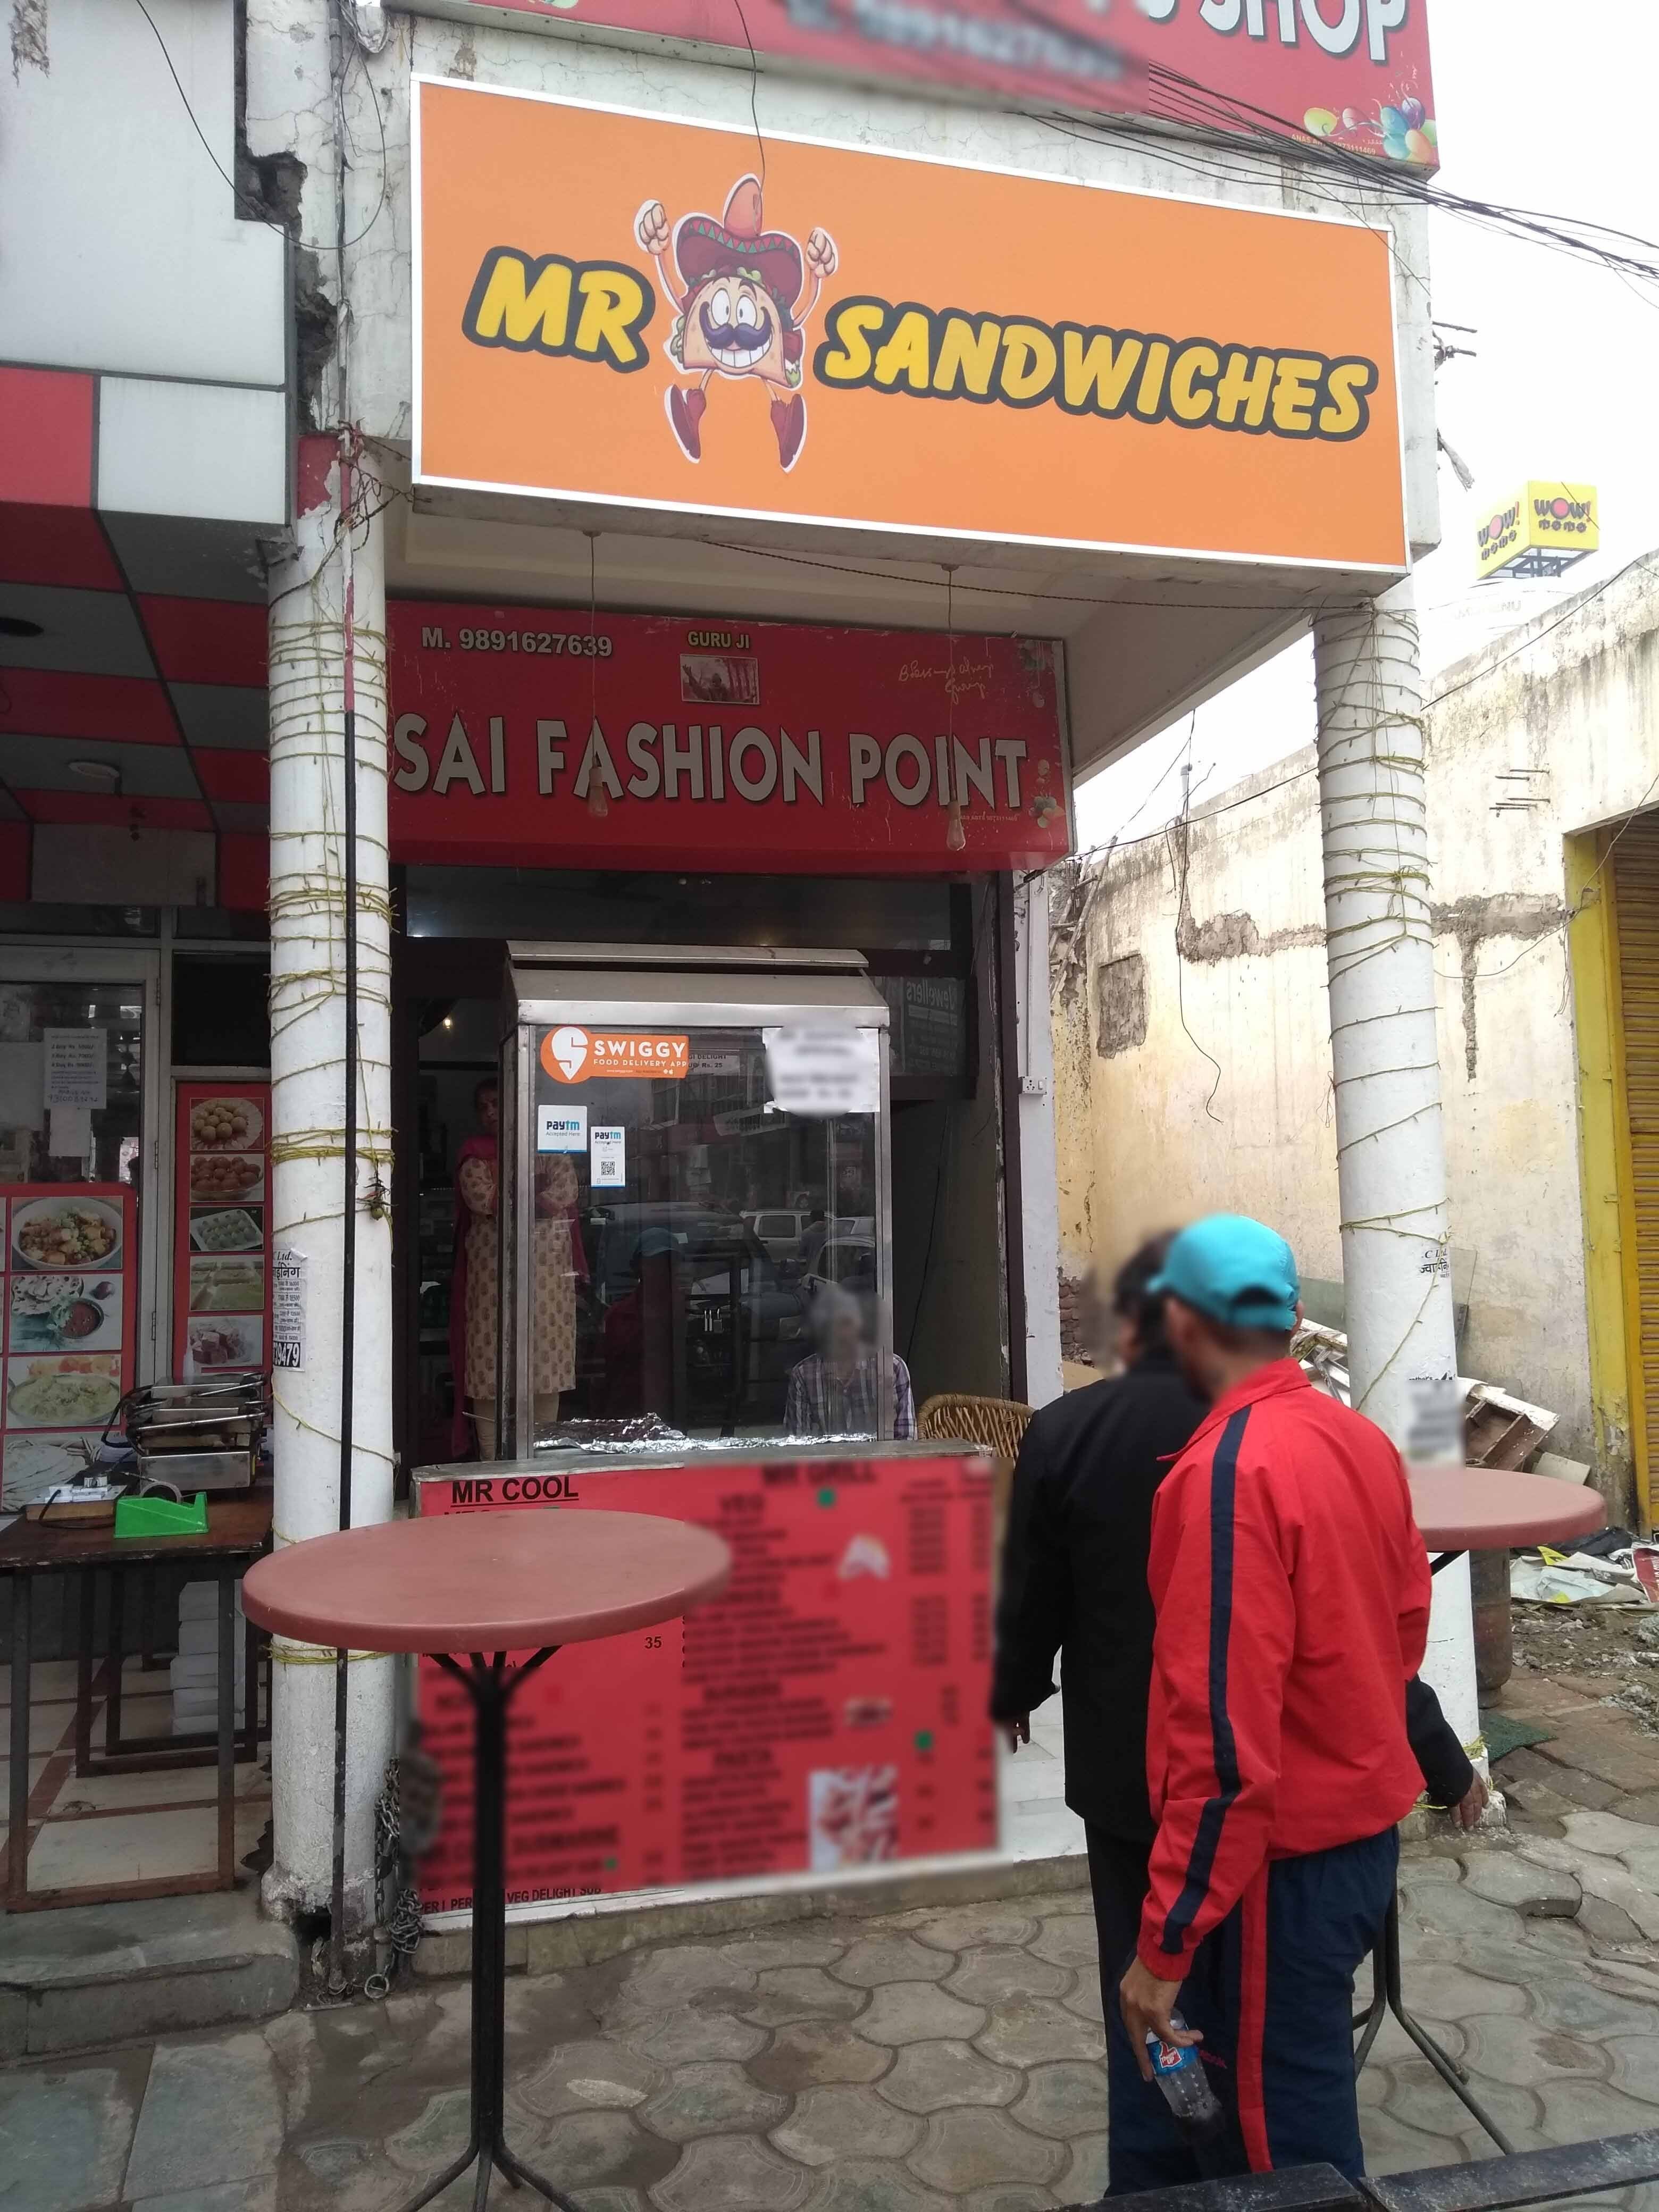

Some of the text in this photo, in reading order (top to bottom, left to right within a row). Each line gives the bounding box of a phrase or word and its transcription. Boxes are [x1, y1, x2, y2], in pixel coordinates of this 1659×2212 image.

[463, 247, 1377, 441] MR SANDWICHES
[422, 627, 612, 657] M. 9891627639
[688, 631, 749, 648] GURU JI
[393, 714, 1027, 809] SAI FASHION POINT
[593, 1040, 686, 1058] SWIGGY
[273, 1342, 300, 1367] 39479
[452, 1476, 579, 1504] MR COOL
[644, 1636, 663, 1649] 35
[507, 1891, 529, 1904] VEG
